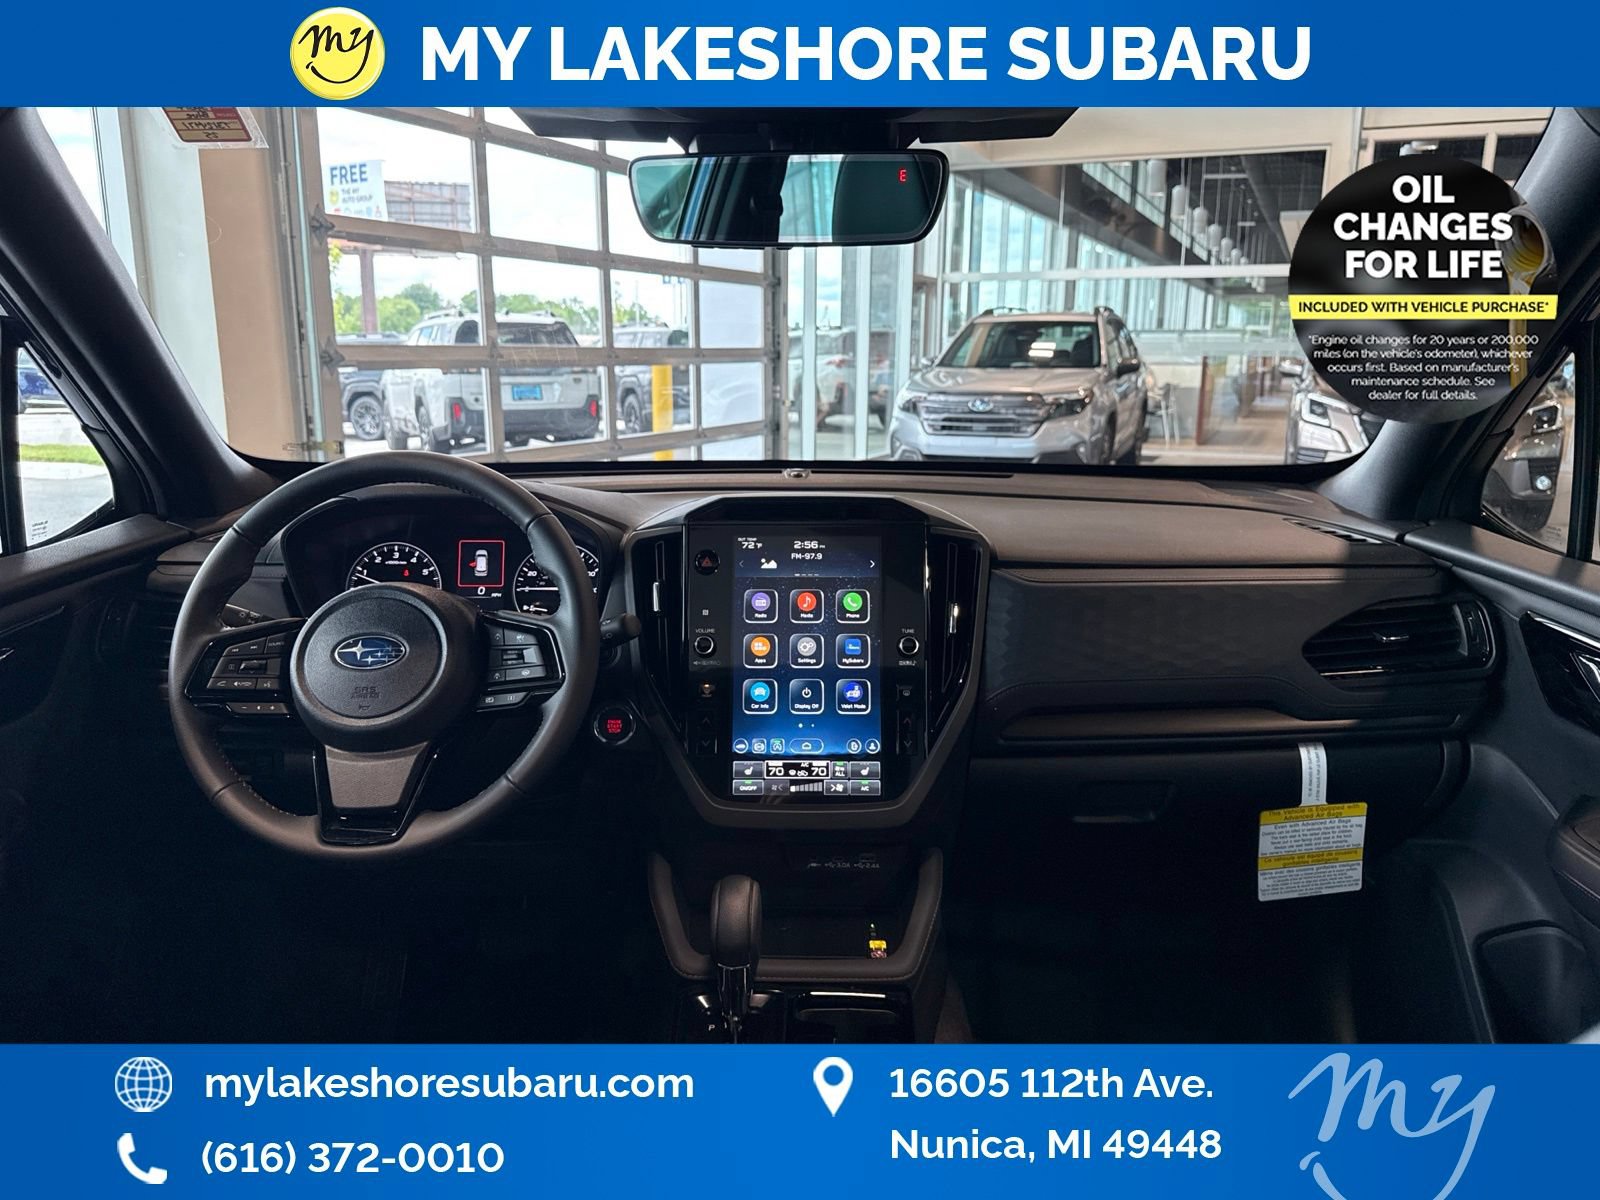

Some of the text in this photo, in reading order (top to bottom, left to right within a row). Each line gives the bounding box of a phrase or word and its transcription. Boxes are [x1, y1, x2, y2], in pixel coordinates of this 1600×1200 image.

[330, 163, 368, 186] FREE
[742, 541, 755, 549] 72
[794, 541, 819, 549] 2:56
[375, 556, 382, 564] 2
[477, 586, 486, 595] 0
[768, 767, 785, 776] 70
[811, 767, 827, 776] 70
